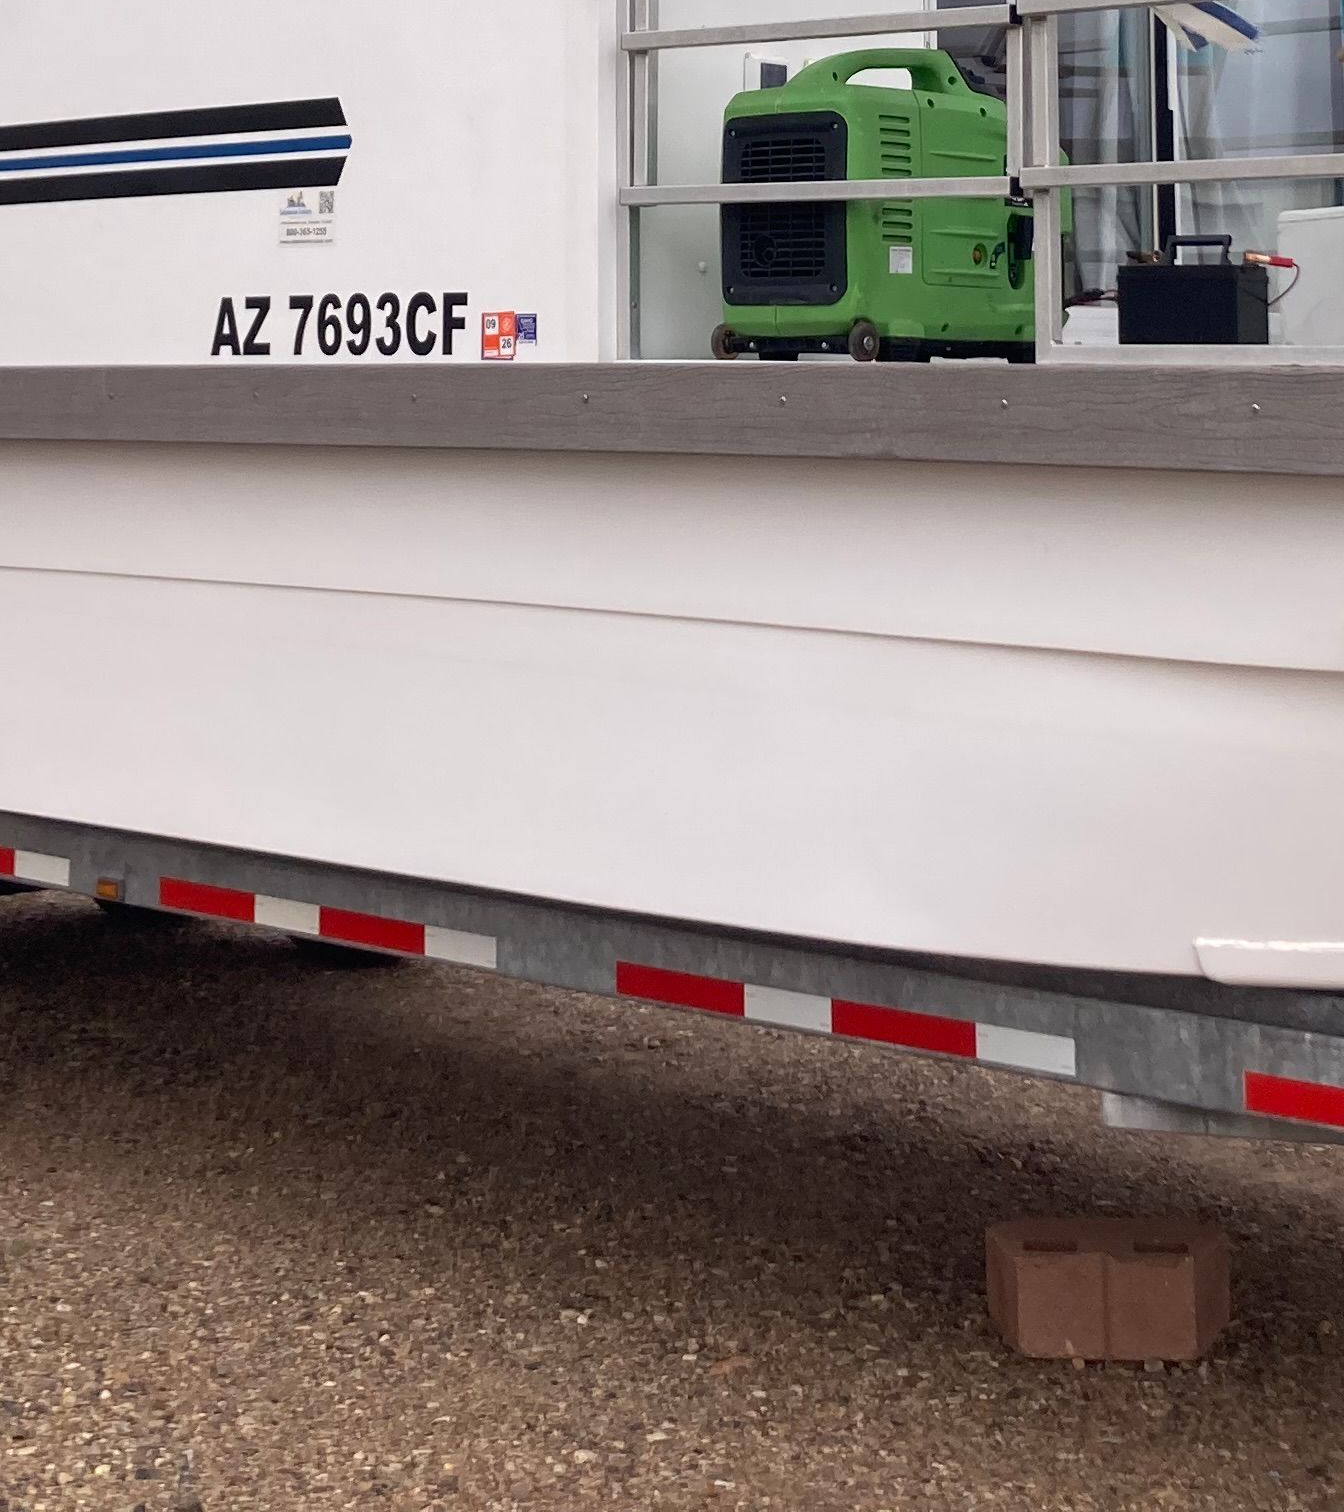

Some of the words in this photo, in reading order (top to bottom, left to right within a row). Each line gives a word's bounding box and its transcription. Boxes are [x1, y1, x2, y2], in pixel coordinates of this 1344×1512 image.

[210, 296, 271, 355] AZ
[288, 291, 468, 356] 7693CF
[485, 318, 497, 329] 09
[501, 338, 513, 349] 26
